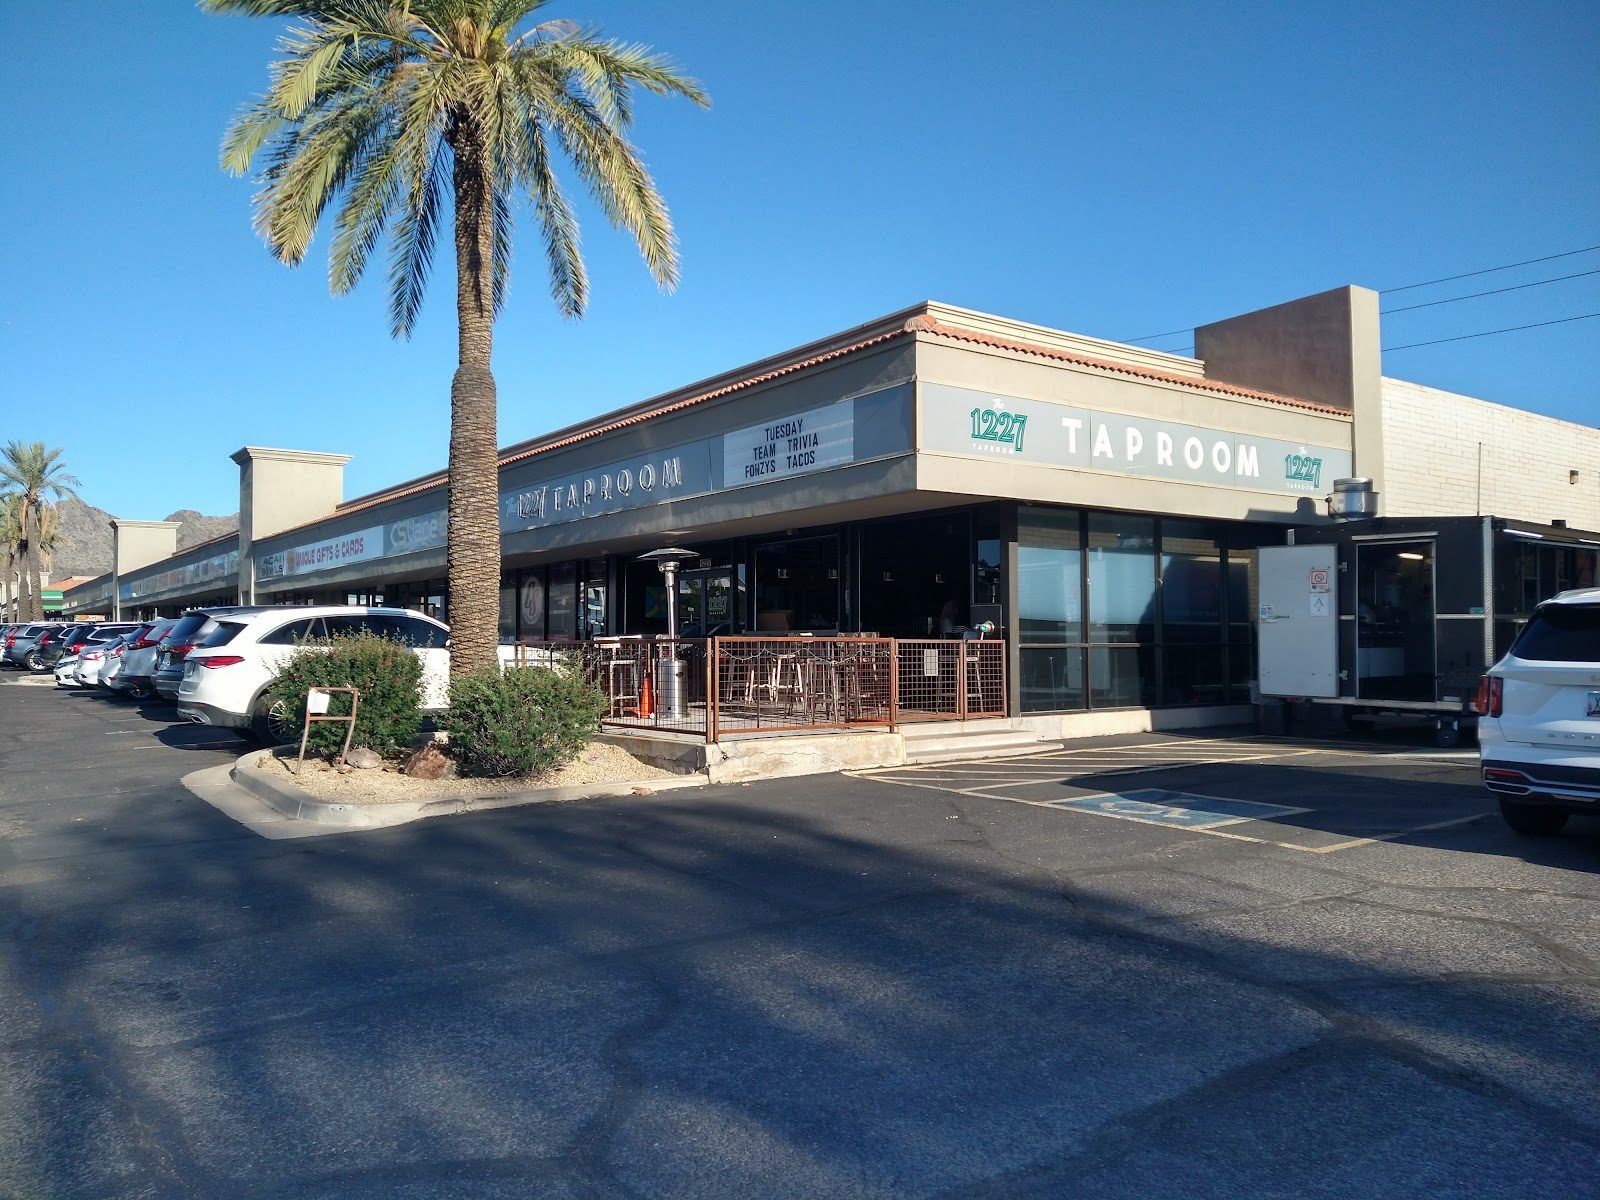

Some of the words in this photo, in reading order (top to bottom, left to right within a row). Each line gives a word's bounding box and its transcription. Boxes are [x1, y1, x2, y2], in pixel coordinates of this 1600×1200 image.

[764, 419, 803, 442] TUESDAY
[970, 407, 1028, 452] 1227
[753, 443, 776, 461] TEAM
[787, 433, 819, 453] TRIVIA
[971, 443, 1014, 455] TAPROOM
[1061, 416, 1260, 478] TAPROOM
[745, 459, 776, 479] FONZYS
[786, 450, 816, 470] TACOS
[1285, 454, 1322, 488] 1227
[553, 457, 682, 511] TAPROOM
[316, 545, 334, 563] GIFTS
[335, 543, 340, 560] &
[341, 537, 364, 558] CARDS
